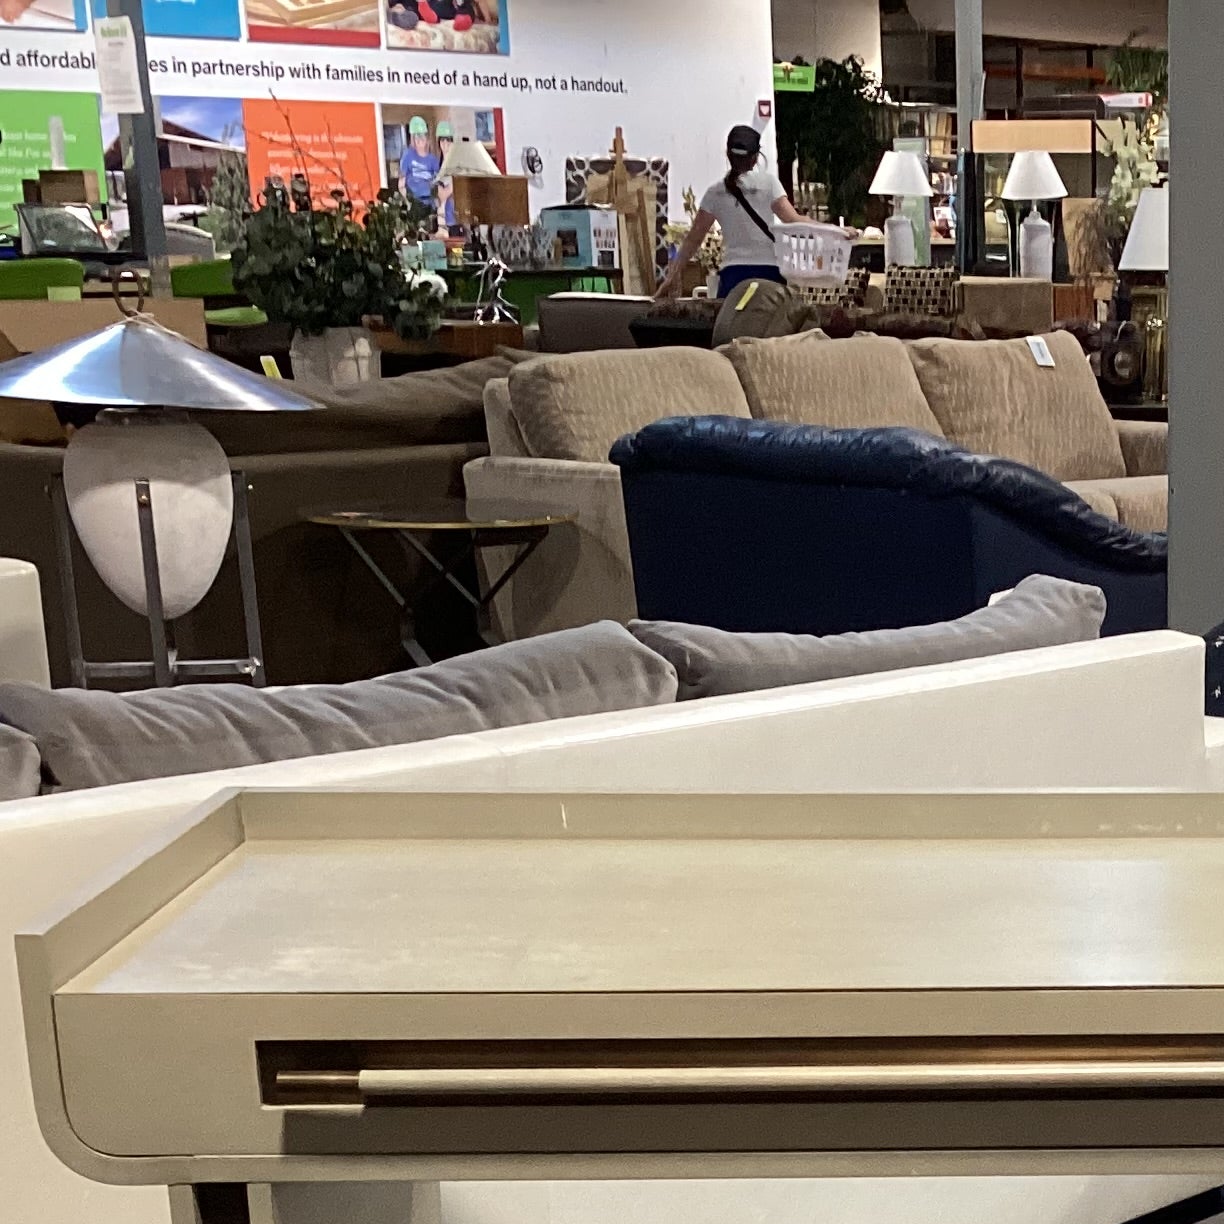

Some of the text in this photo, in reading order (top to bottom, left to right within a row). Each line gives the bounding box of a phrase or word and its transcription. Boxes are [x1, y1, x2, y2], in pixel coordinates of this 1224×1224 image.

[16, 49, 97, 70] affordabl
[172, 56, 187, 74] in
[192, 58, 285, 81] partnership
[289, 62, 321, 80] with
[326, 63, 384, 82] families
[387, 66, 400, 83] in
[404, 68, 440, 85] need
[444, 70, 459, 86] of
[462, 74, 470, 87] a
[473, 71, 507, 89] hand
[511, 76, 532, 93] up,
[536, 75, 557, 91] not
[560, 79, 568, 91] a
[571, 76, 628, 94] handout.
